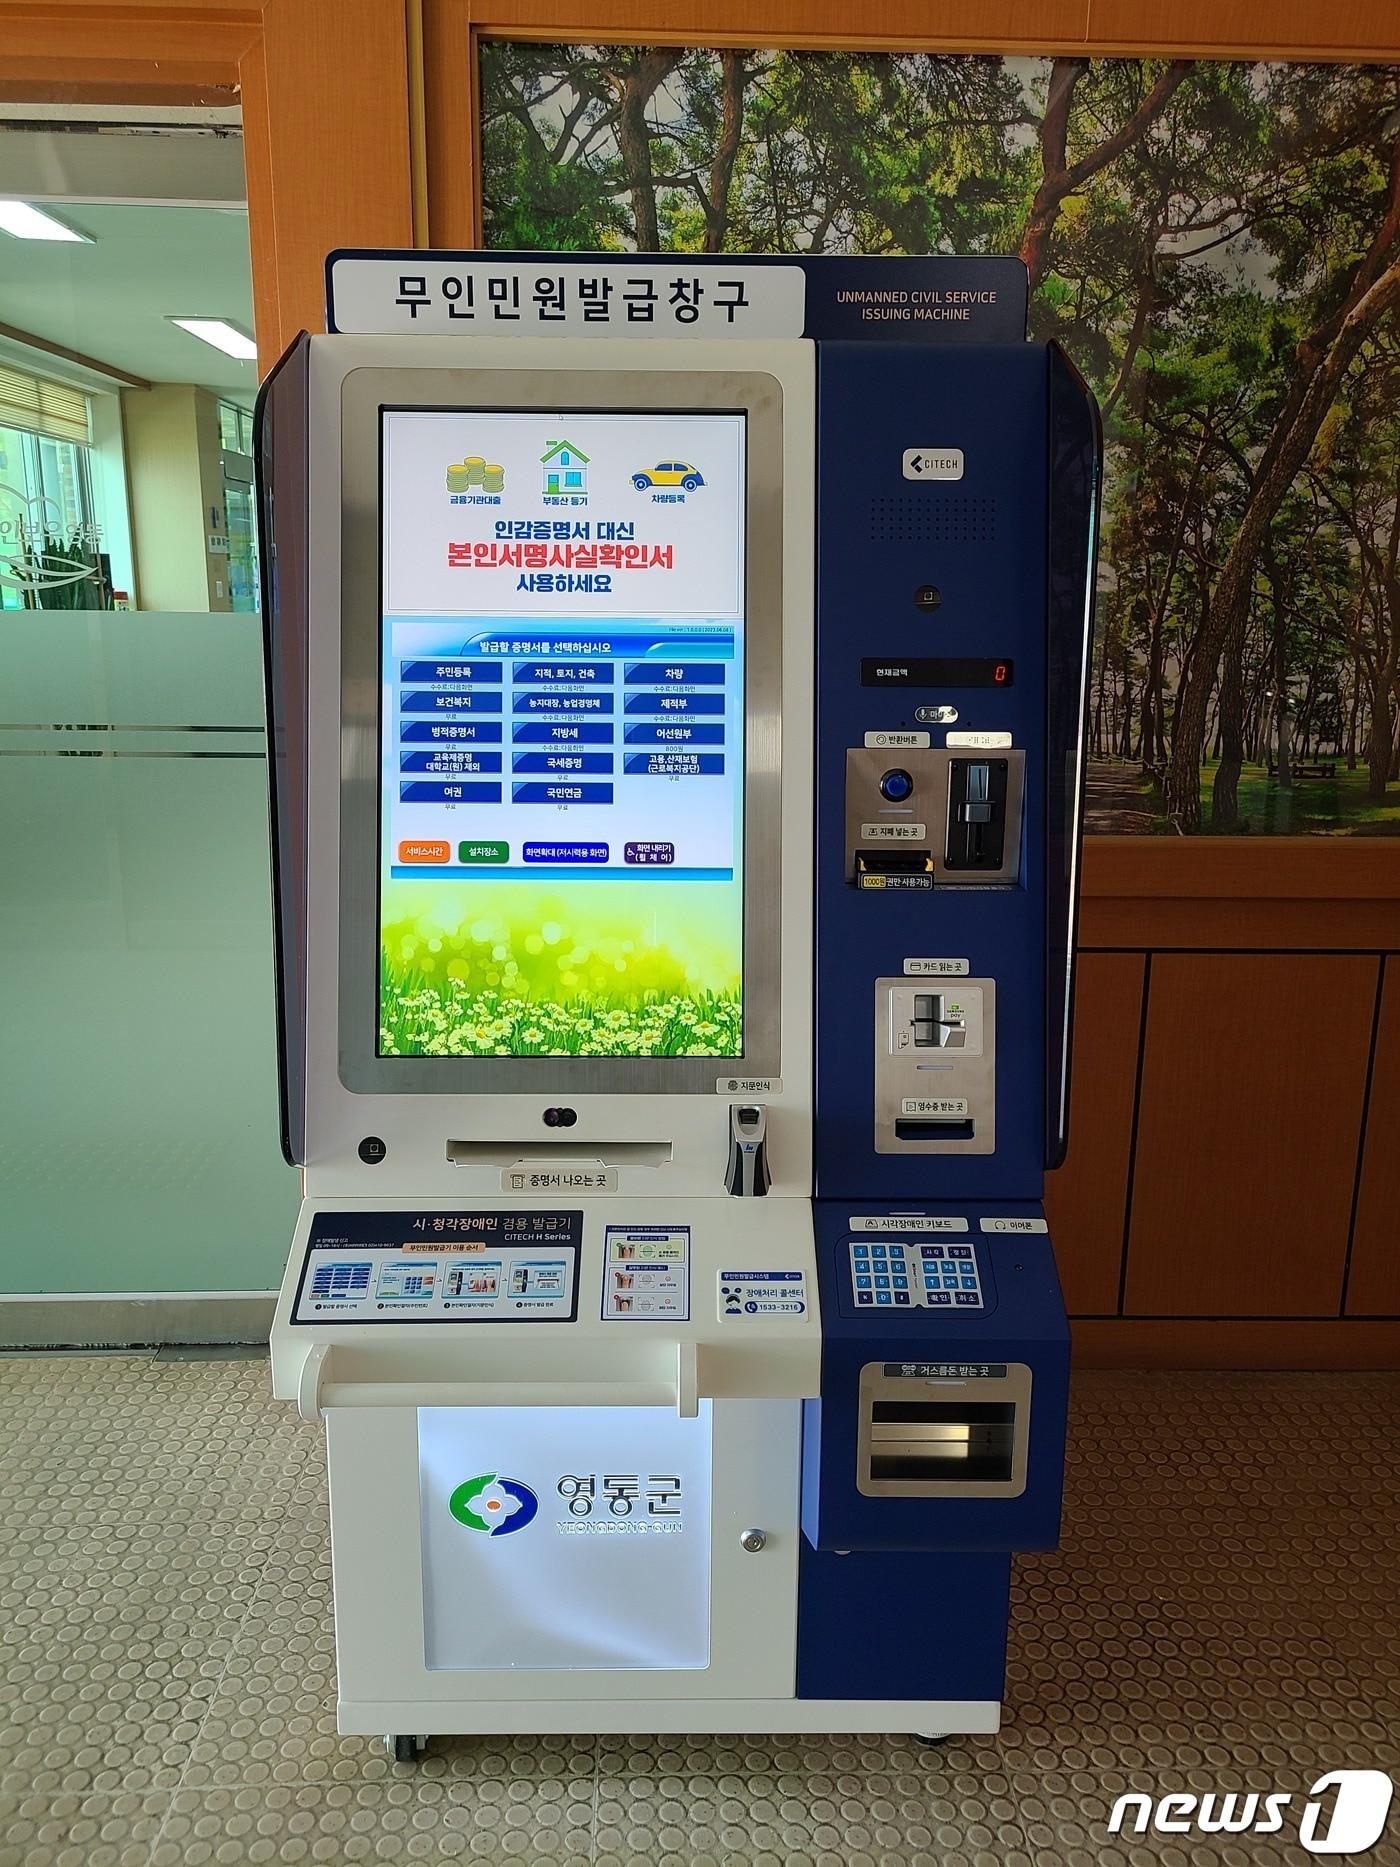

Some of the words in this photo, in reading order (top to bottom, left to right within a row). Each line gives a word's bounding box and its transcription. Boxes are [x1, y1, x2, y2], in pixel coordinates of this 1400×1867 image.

[395, 276, 750, 323] 무인민원발급창구
[837, 291, 908, 303] UNMANNED
[911, 291, 942, 303] CIVIL
[945, 291, 996, 304] SERVICE
[862, 308, 911, 320] ISSUING
[914, 308, 970, 320] MACHINE
[924, 459, 958, 469] CITECH
[542, 496, 568, 506] 부동산
[570, 496, 588, 506] 등기
[651, 494, 685, 504] 차량등록
[494, 520, 590, 540] 인감증명서
[597, 521, 635, 541] 대신
[447, 543, 673, 569] 본인서명사실확인서
[516, 574, 612, 593] 사용하세요
[480, 641, 509, 653] 발급할
[512, 641, 551, 653] 증명서를
[553, 642, 611, 653] 선택하십시오
[436, 667, 471, 678] 주민등록
[534, 669, 554, 679] 지적,
[556, 669, 576, 679] 토지,
[578, 669, 596, 679] 건축
[665, 669, 683, 679] 차량
[995, 666, 1006, 681] 0
[436, 697, 471, 707] 보건복지
[660, 698, 688, 709] 제적부
[431, 726, 476, 738] 병적증명서
[551, 727, 579, 738] 지방세
[656, 728, 692, 739] 어선원부
[888, 735, 918, 745] 반환버튼
[464, 762, 480, 772] 제외
[547, 758, 583, 769] 국세증명
[444, 787, 462, 797] 여권
[547, 788, 582, 798] 국민연금
[896, 828, 909, 836] 넣는
[911, 828, 918, 836] 곳
[406, 847, 443, 856] 서비스시간
[468, 847, 499, 856] 설치장소
[526, 848, 556, 857] 화면확대
[589, 848, 607, 857] 화면)
[902, 877, 930, 887] 사용가능
[923, 963, 937, 971] 카드
[939, 963, 953, 971] 읽는
[954, 963, 962, 971] 곳
[741, 1081, 770, 1090] 지문인식
[918, 1102, 939, 1111] 영수증
[940, 1102, 954, 1111] 받는
[956, 1102, 963, 1111] 곳
[529, 1174, 560, 1187] 증명서
[563, 1174, 593, 1187] 나오는
[596, 1174, 606, 1187] 곳
[413, 1218, 498, 1231] 시·청각장애인
[502, 1218, 528, 1230] 겸용
[532, 1217, 571, 1230] 발급기
[881, 1220, 924, 1229] 시각장애인
[926, 1220, 952, 1228] 키보드
[504, 1233, 534, 1241] CITECH
[746, 1289, 778, 1298] 장애처리
[779, 1289, 804, 1298] 콜센터
[920, 1366, 957, 1376] 거스름돈
[959, 1366, 978, 1376] 받는
[980, 1366, 989, 1376] 곳
[557, 1474, 682, 1517] 영동군
[557, 1521, 682, 1535] YEONGDONG-GUN
